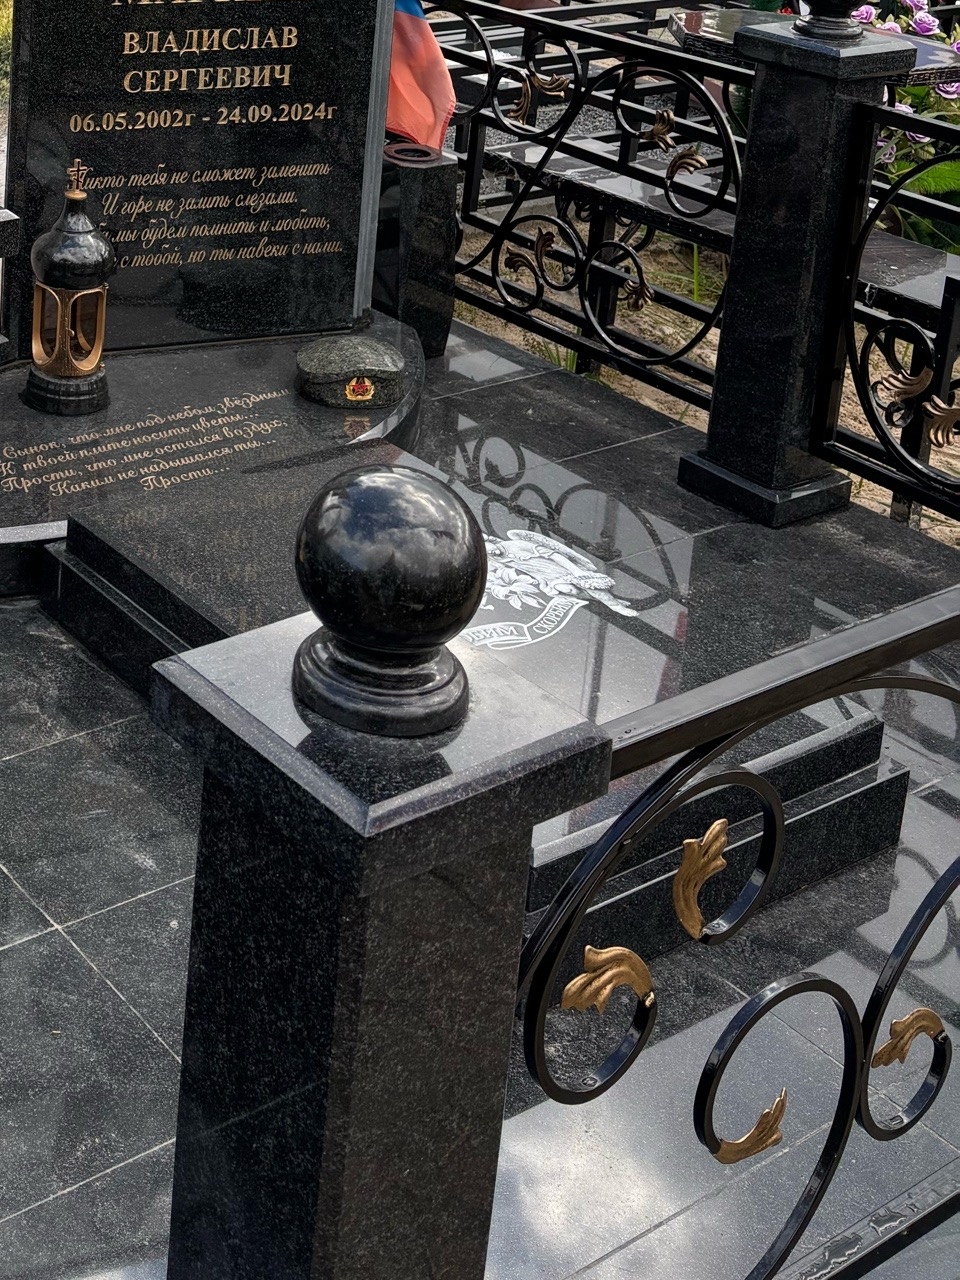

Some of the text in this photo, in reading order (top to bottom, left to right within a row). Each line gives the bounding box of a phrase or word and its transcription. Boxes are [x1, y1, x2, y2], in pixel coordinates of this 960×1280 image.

[122, 25, 299, 57] ВЛАДИСЛАВ
[123, 64, 293, 93] СЕРГЕЕВИЧ
[69, 108, 196, 133] 06.05.2002г
[216, 102, 339, 126] 24.09.2024г
[127, 164, 170, 187] тебя
[170, 171, 189, 184] не
[192, 167, 256, 183] сможет
[253, 162, 333, 187] заменить
[101, 192, 120, 216] И
[121, 194, 154, 223] горе
[155, 200, 175, 212] не
[170, 194, 234, 219] залить
[141, 217, 187, 249] будем
[189, 221, 257, 238] помнить
[258, 220, 271, 232] и
[130, 243, 183, 268] тобой,
[189, 250, 207, 264] но
[209, 247, 238, 262] ты
[238, 236, 290, 260] навеки
[291, 243, 301, 255] с
[2, 440, 67, 459] Сынок,
[68, 431, 101, 445] что
[100, 423, 136, 438] мне
[136, 413, 166, 429] под
[167, 405, 216, 421] небом
[0, 468, 83, 493] Прости,
[85, 457, 117, 472] что
[120, 450, 153, 463] мне
[155, 432, 223, 455] остался
[22, 450, 78, 471] твоей
[79, 438, 132, 459] плите
[133, 426, 191, 445] носить
[49, 476, 116, 497] Каким
[118, 469, 139, 481] не
[139, 446, 234, 475] надышался
